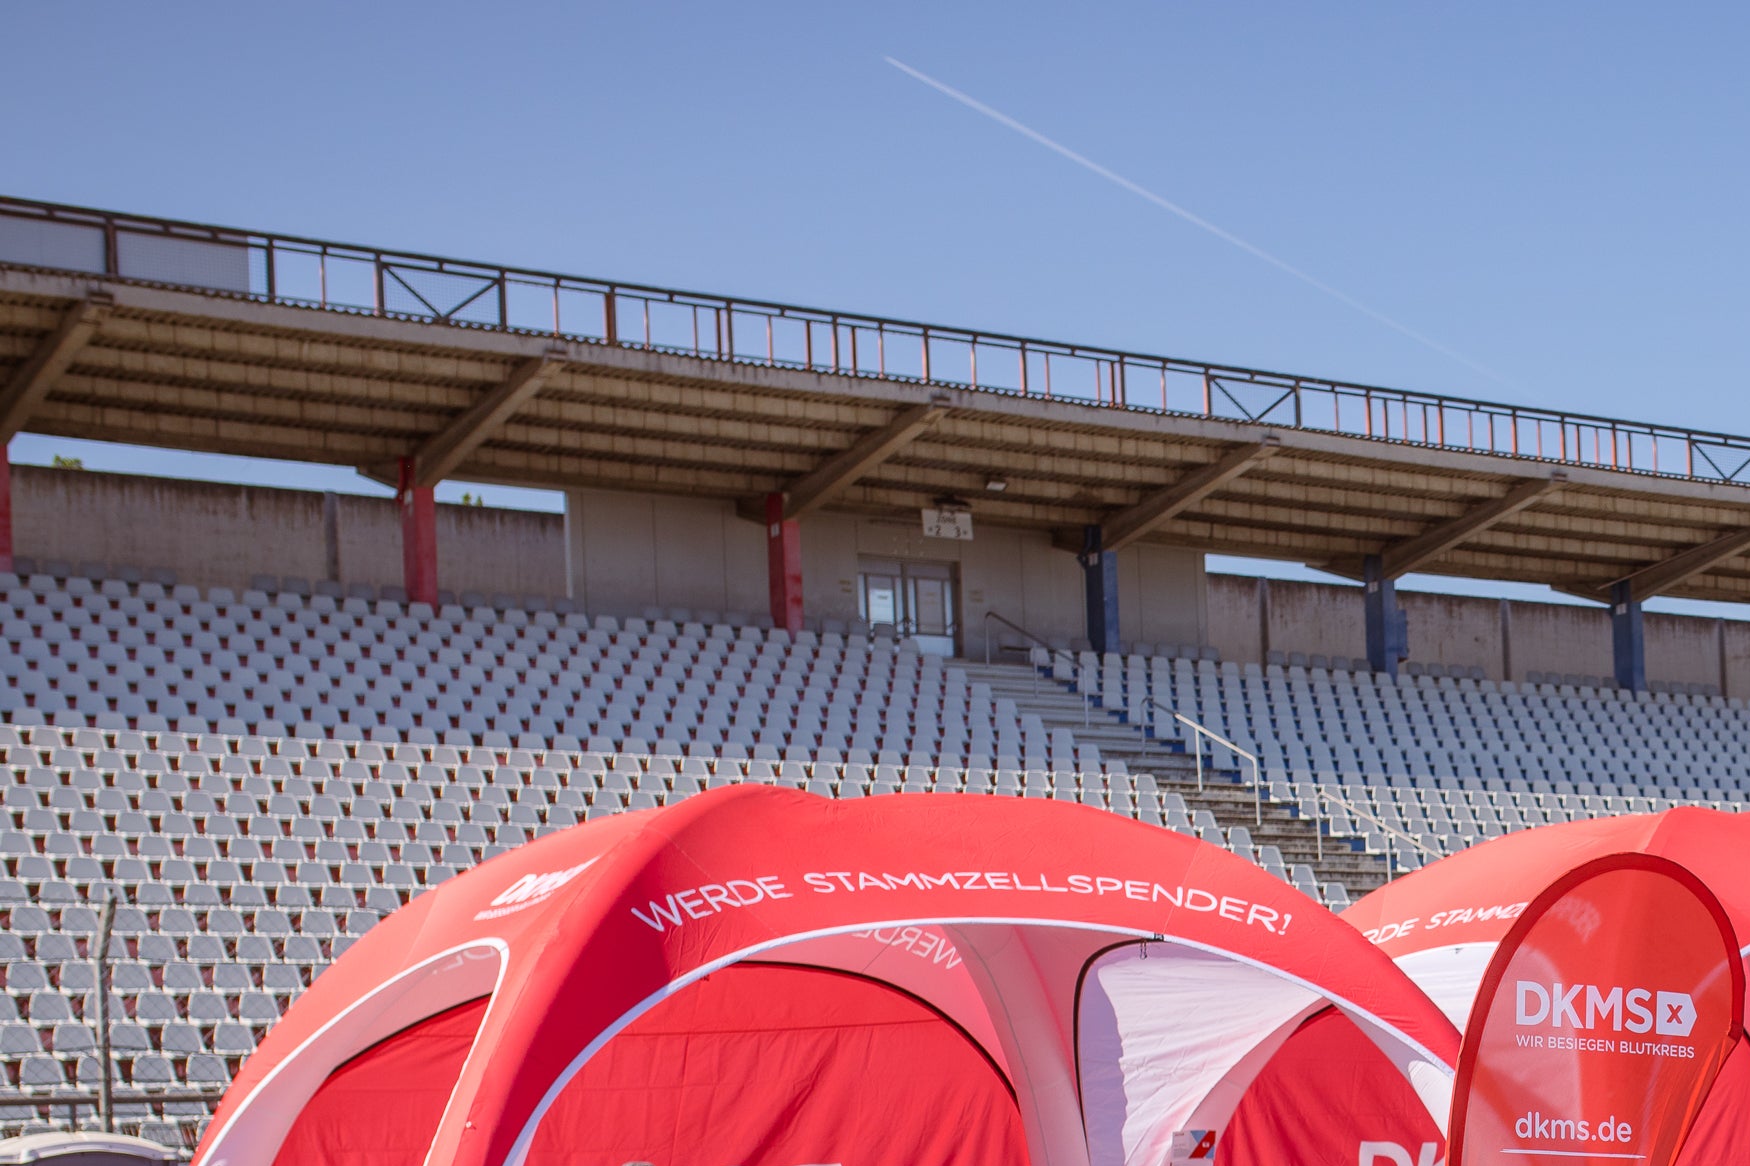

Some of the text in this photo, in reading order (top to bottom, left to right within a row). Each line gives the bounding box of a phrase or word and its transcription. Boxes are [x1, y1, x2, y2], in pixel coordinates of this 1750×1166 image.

[631, 872, 1293, 935] WERDE STAMMZELLSPENDER!
[1362, 917, 1420, 945] RDE
[1516, 980, 1654, 1034] DKMS
[1516, 1034, 1695, 1059] WIR BESIEGEN BLUTKREBS
[1515, 1111, 1633, 1143] dkms.de
